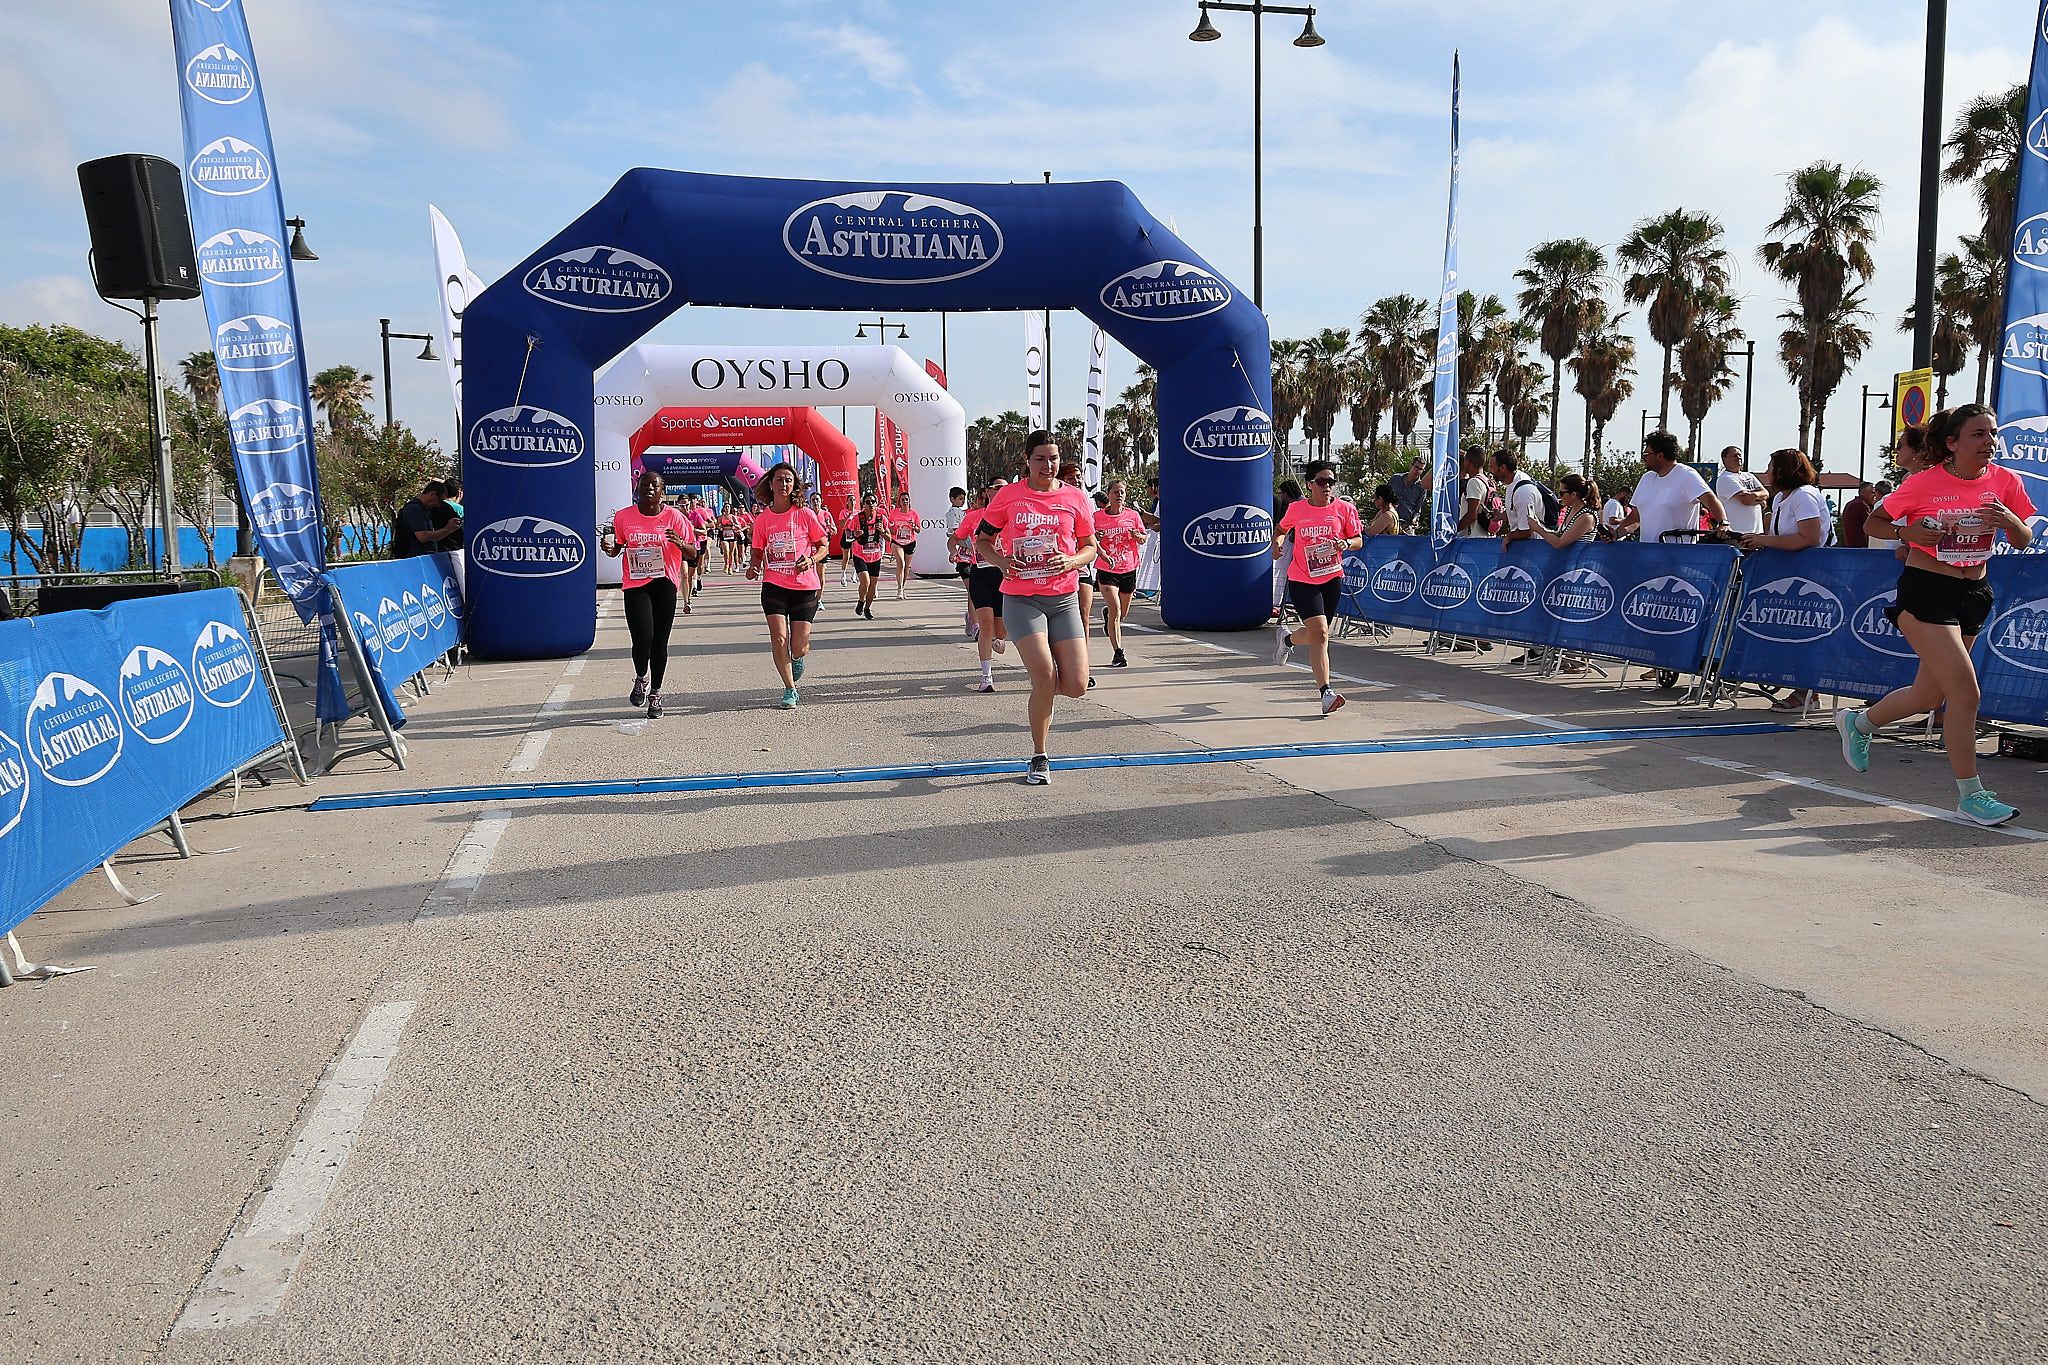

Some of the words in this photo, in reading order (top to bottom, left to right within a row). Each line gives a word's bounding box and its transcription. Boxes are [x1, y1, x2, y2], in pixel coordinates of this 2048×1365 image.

[835, 215, 904, 227] CENTRAL
[910, 218, 980, 230] LECHERA
[801, 216, 987, 260] ASTURIANA
[558, 265, 607, 276] CENTRAL
[611, 268, 660, 281] LECHERA
[533, 267, 661, 300] ASTURIANA
[1132, 280, 1176, 290] CENTRAL
[1111, 286, 1226, 308] ASTURIANA
[691, 358, 850, 390] OYSHO
[594, 395, 643, 406] OYSHO
[894, 392, 939, 403] OYSHO
[490, 425, 532, 433] CENTRAL
[535, 427, 575, 436] LECHERA
[660, 416, 701, 431] Sports
[721, 416, 786, 428] Santander
[475, 428, 578, 454] ASTURIANA
[1191, 427, 1271, 448] ASTURIANA
[594, 460, 621, 471] SHO
[919, 456, 962, 467] OYSHO
[921, 519, 946, 529] OYS
[1016, 512, 1060, 525] CARRERA
[493, 536, 533, 544] CENTRAL
[538, 537, 576, 545] LECHERA
[1191, 525, 1271, 546] ASTURIANA
[1301, 526, 1333, 537] CARRERA
[1956, 535, 1979, 543] 016
[477, 538, 579, 562] ASTURIANA
[1026, 555, 1044, 563] 016
[1374, 574, 1412, 593] ASTURIANA
[1423, 579, 1466, 599] ASTURIANA
[1479, 583, 1530, 603] ASTURIANA
[1546, 586, 1607, 611] ASTURIANA
[1625, 594, 1697, 623] ASTURIANA
[1742, 598, 1832, 629] ASTURIANA
[126, 681, 191, 728] ASTURIANA
[43, 709, 74, 730] CENTRAL
[38, 713, 119, 770] ASTURIANA
